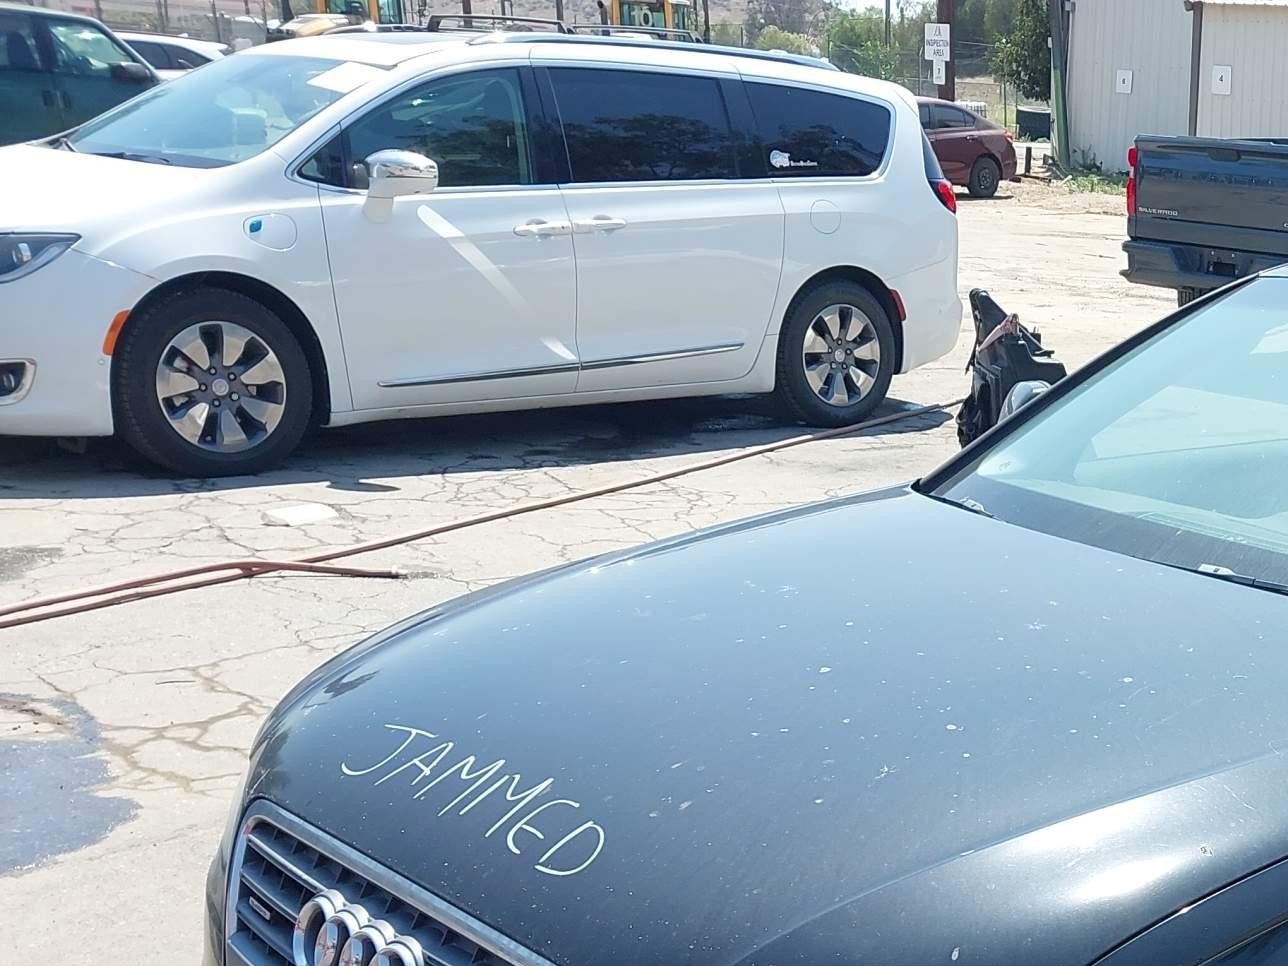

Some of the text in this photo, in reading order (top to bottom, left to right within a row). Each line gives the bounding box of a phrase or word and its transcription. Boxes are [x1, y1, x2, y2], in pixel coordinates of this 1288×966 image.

[1218, 74, 1224, 82] 4
[1138, 206, 1178, 216] SILVERADO
[341, 723, 605, 876] JAMMED
